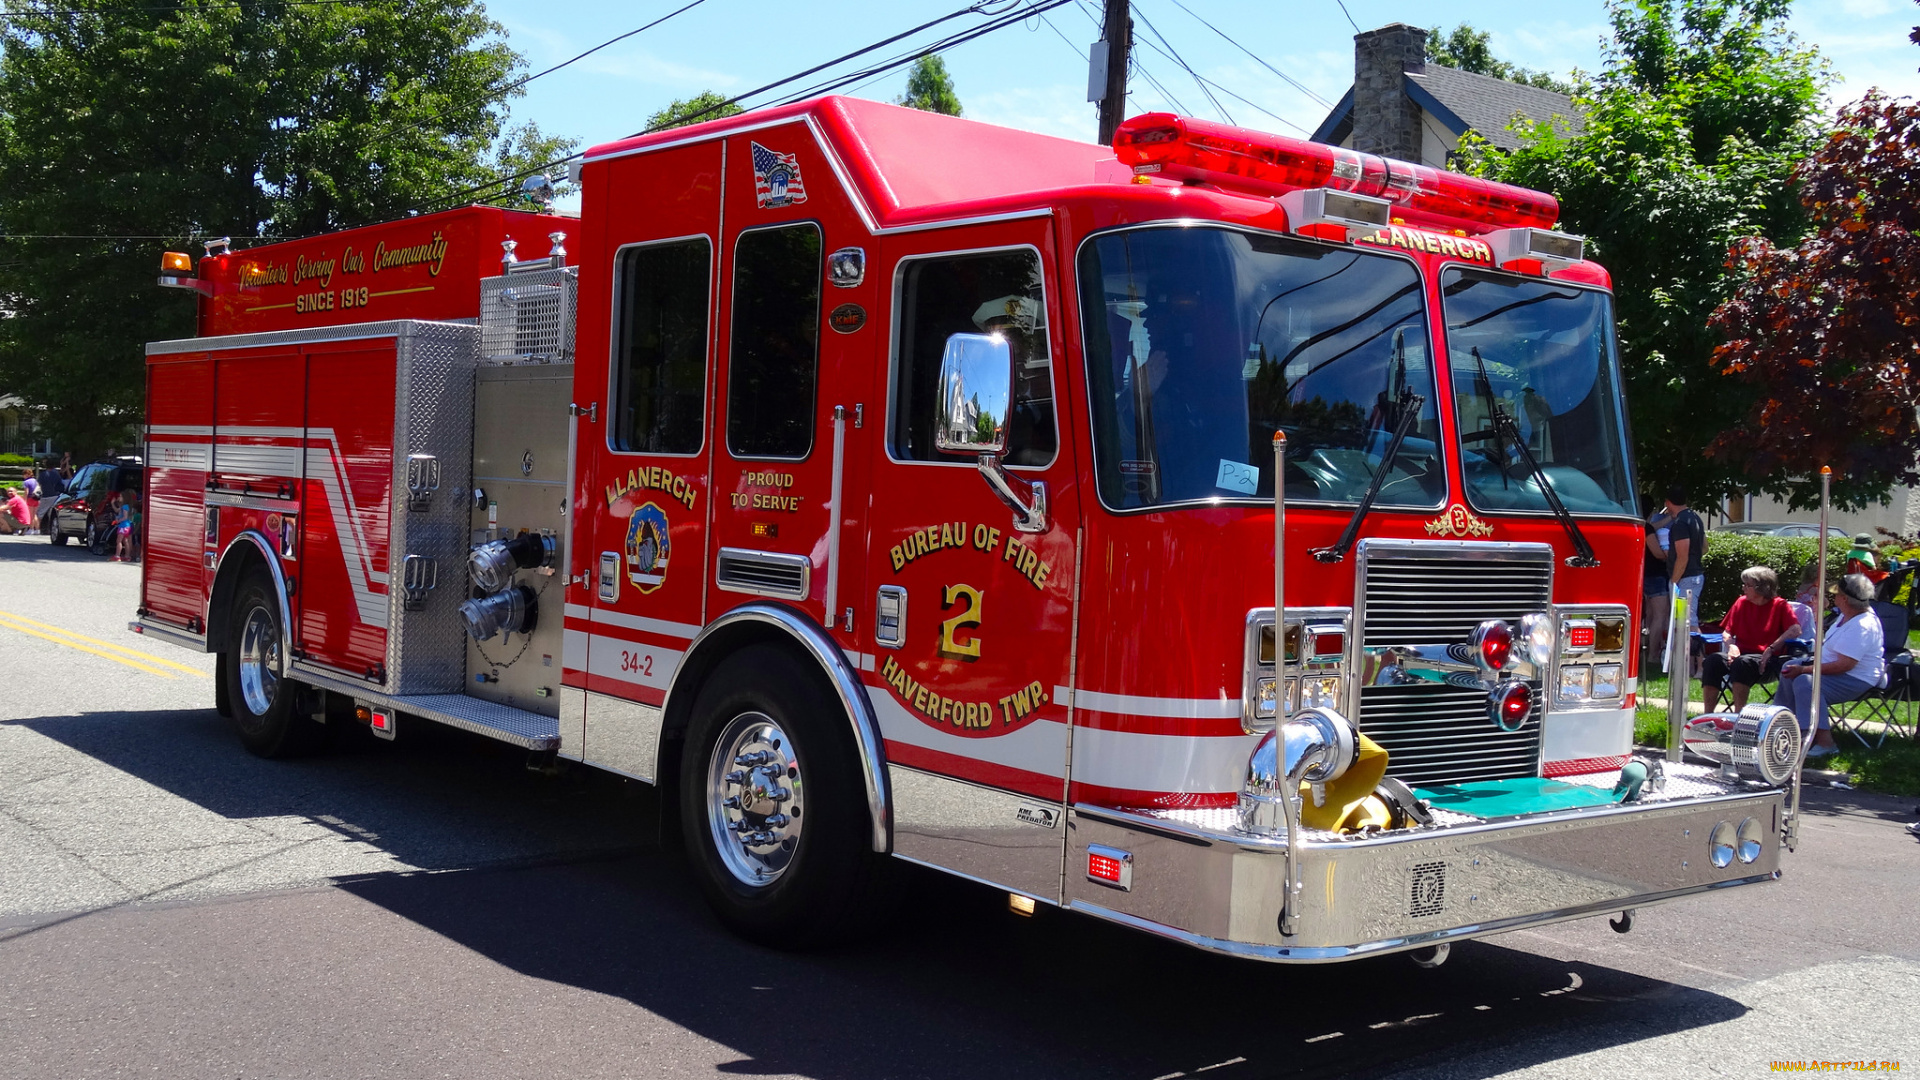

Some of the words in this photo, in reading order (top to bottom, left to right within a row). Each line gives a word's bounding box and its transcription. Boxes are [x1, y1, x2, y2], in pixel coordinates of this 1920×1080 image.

[238, 260, 289, 292] Volunteers
[294, 252, 336, 289] Serving
[342, 246, 366, 273] Our
[373, 230, 449, 276] Community
[296, 291, 335, 314] SINCE
[340, 286, 370, 309] 1913
[605, 466, 698, 511] LLANERCH
[742, 469, 794, 488] "PROUD
[1222, 463, 1255, 487] P-2
[730, 492, 749, 508] TO
[752, 493, 805, 512] SERVE"
[1453, 509, 1466, 529] 2
[889, 521, 967, 572] BUREAU
[973, 523, 1001, 553] OF
[1004, 535, 1051, 591] FIRE
[941, 583, 985, 657] 2
[620, 650, 653, 677] 34-2
[881, 654, 993, 729] HAVERFORD
[998, 679, 1050, 724] TWP.
[1016, 813, 1053, 827] PREDATOR
